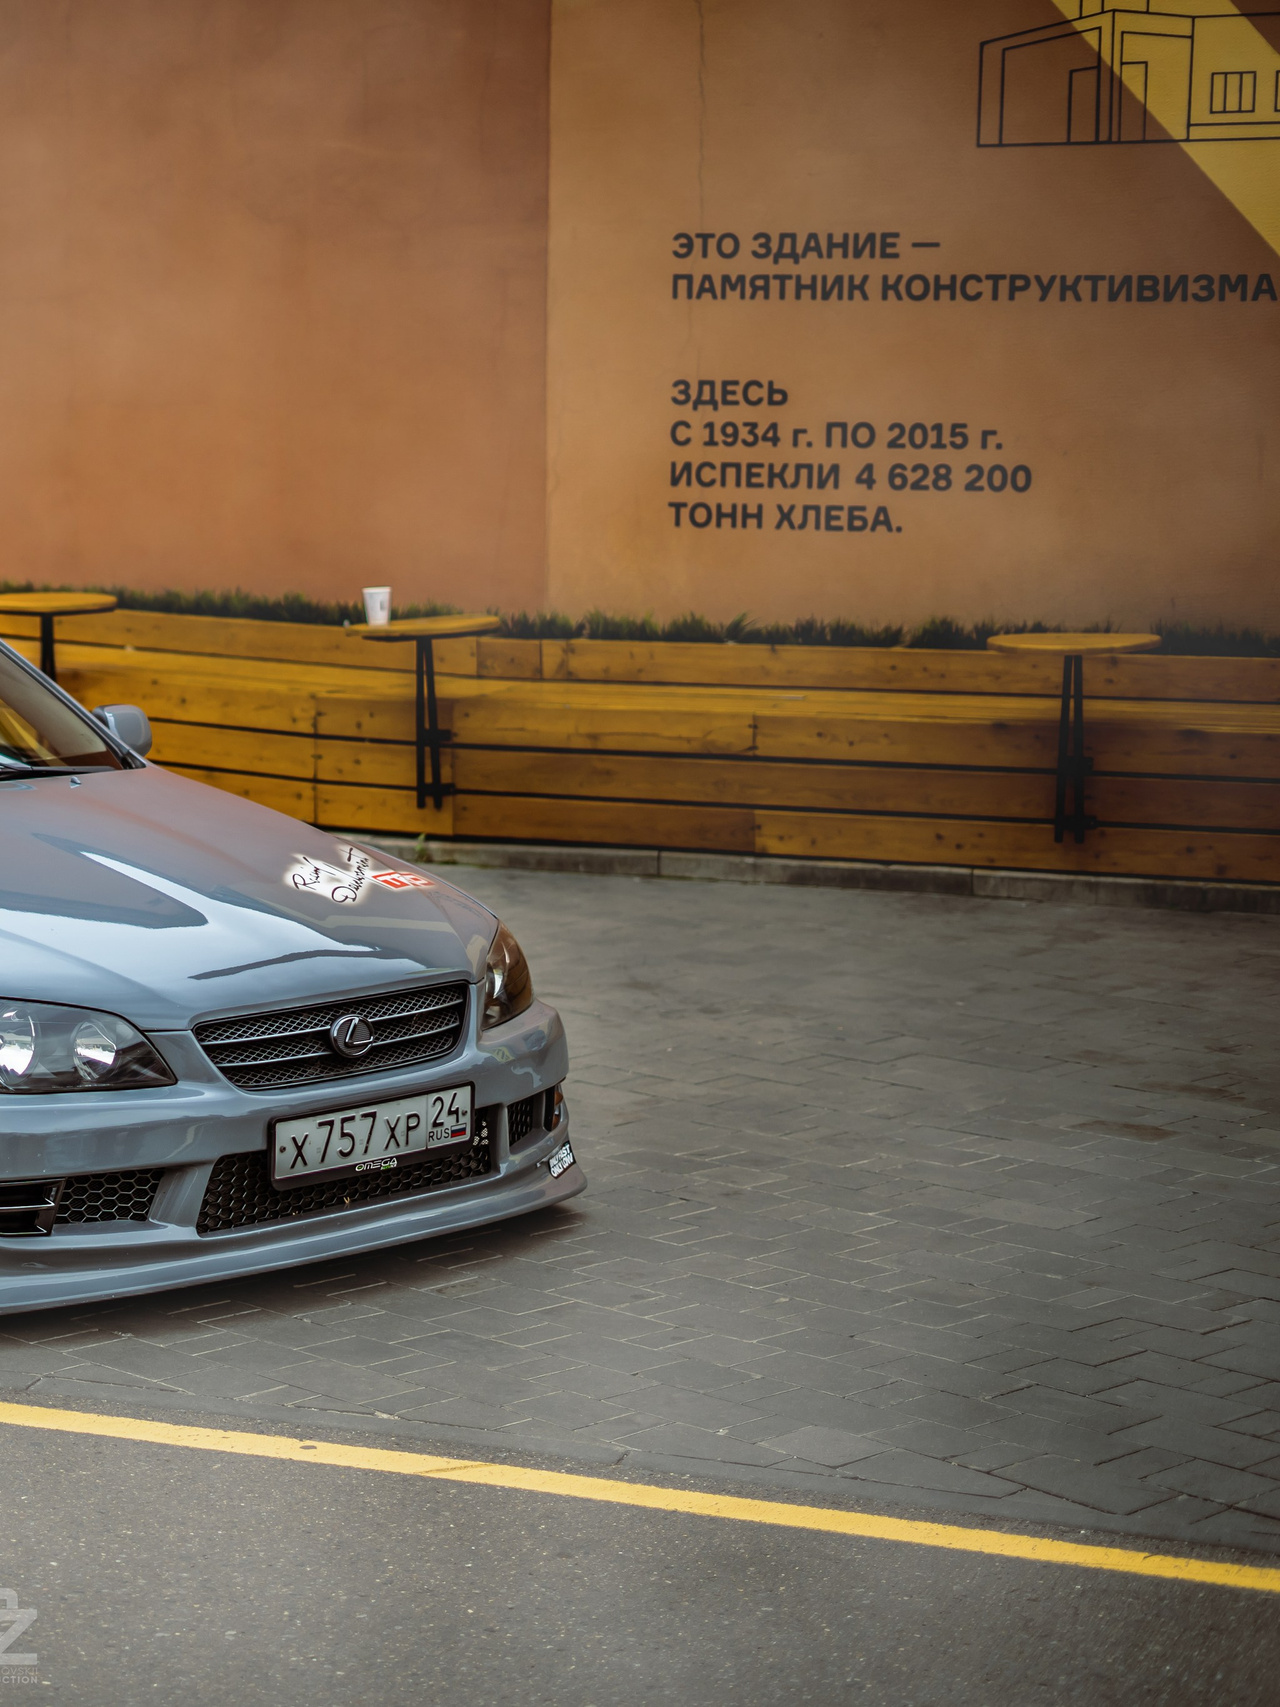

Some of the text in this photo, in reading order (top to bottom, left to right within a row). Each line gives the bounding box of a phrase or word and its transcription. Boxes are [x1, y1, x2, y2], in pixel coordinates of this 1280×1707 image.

[671, 231, 741, 260] ЭТО
[750, 231, 901, 266] ЗДАНИЕ
[671, 273, 1279, 303] ПАМЯТНИК КОНСТРУКТИВИЗМА
[670, 378, 789, 412] ЗДЕСЬ
[669, 419, 1003, 451] С 1934 г. ПО 2015 г.
[669, 460, 1033, 494] ИСПЕКЛИ 4 628 200
[667, 501, 903, 534] ТОНН ХЛЕБА.
[431, 1091, 460, 1128] 24
[428, 1127, 450, 1143] RUS
[355, 1157, 397, 1171] OMEGA
